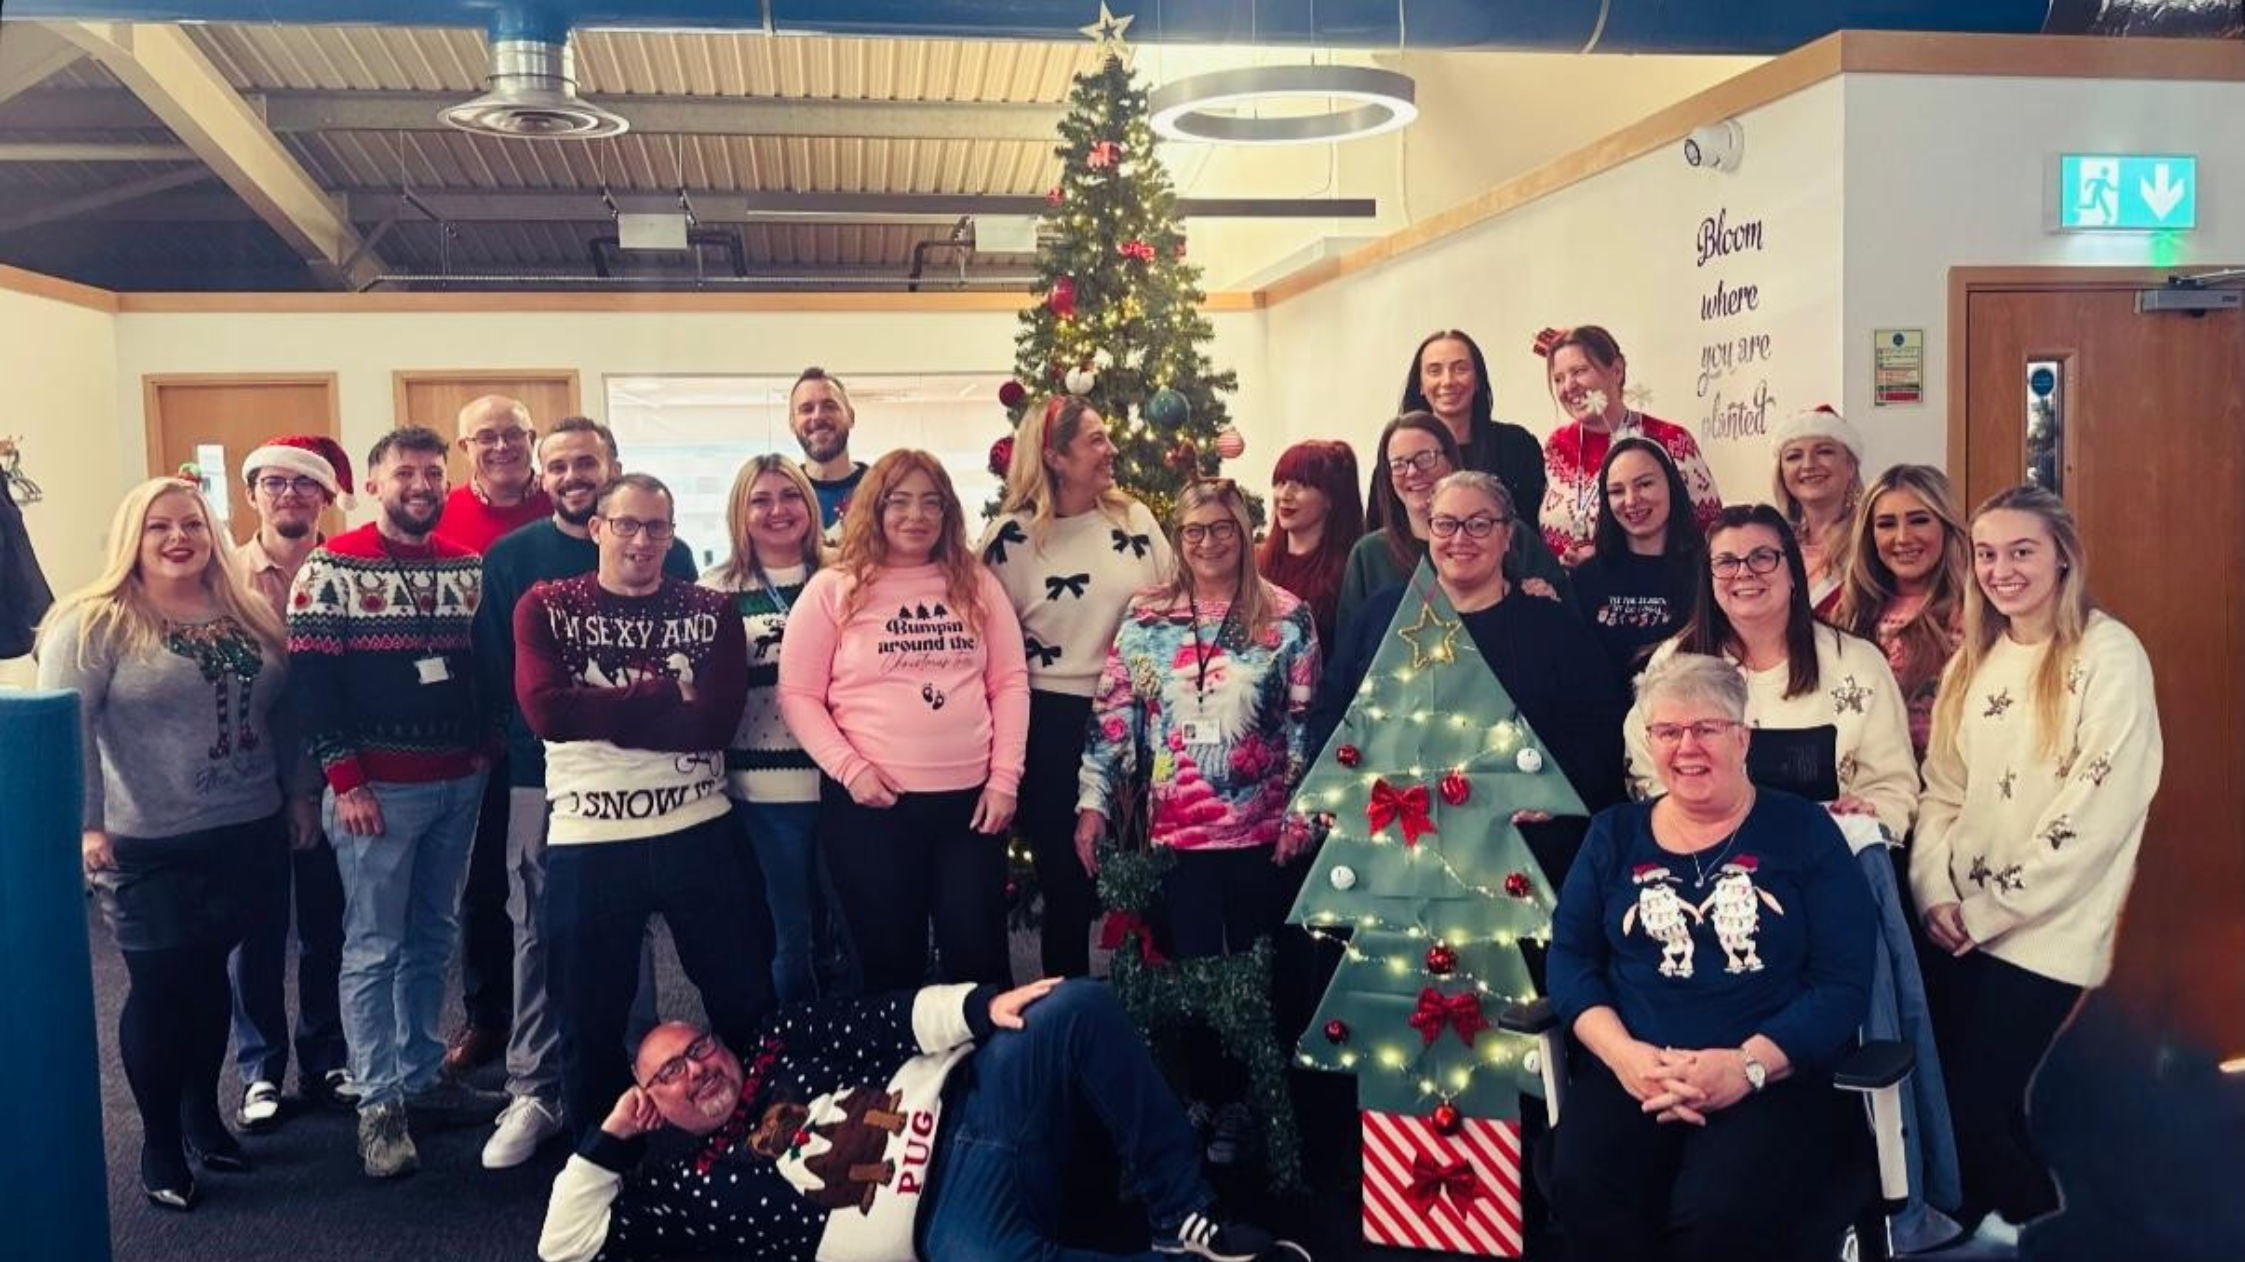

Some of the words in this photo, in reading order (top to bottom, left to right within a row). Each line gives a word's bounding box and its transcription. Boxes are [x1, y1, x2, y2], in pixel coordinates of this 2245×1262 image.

[1697, 208, 1763, 267] Bloom
[1700, 279, 1759, 321] where
[1697, 342, 1737, 397] you
[1738, 333, 1772, 363] are
[585, 614, 654, 649] SEXY
[661, 613, 718, 649] AND
[878, 636, 945, 654] around
[950, 635, 975, 650] the
[583, 785, 690, 820] SNOW
[897, 1109, 934, 1195] PUG
